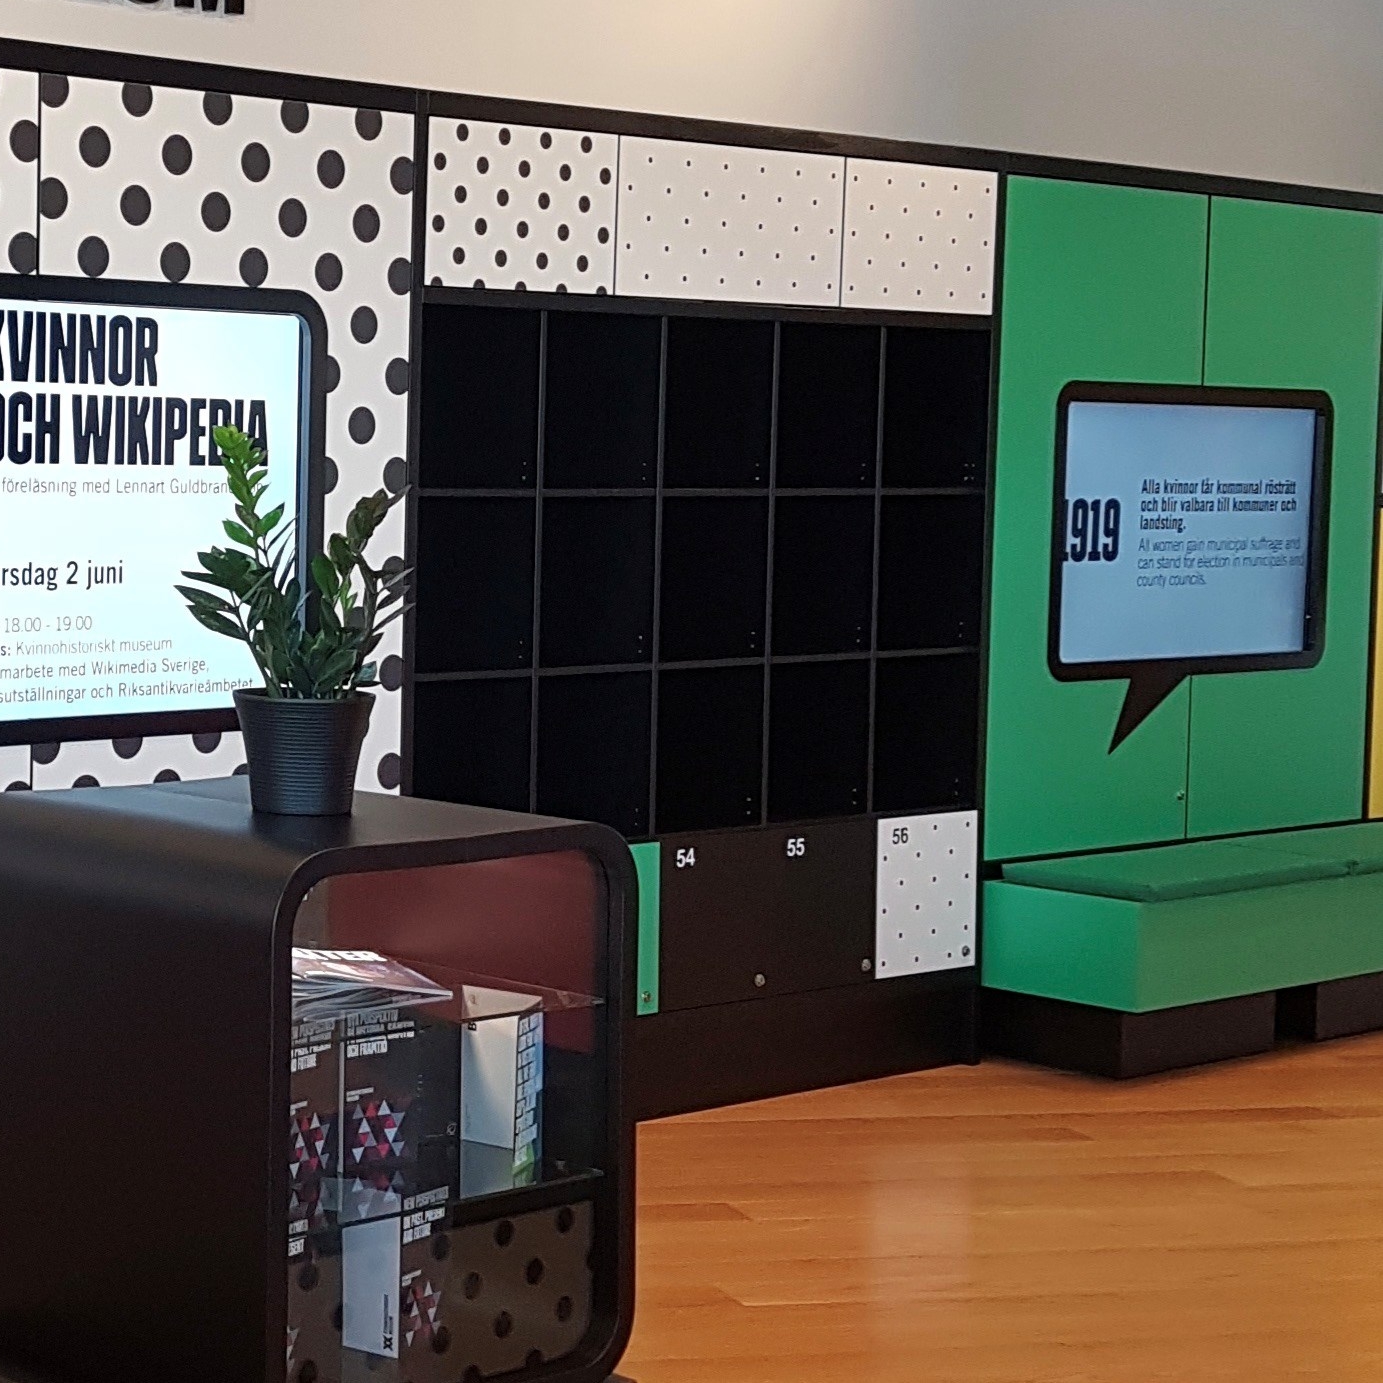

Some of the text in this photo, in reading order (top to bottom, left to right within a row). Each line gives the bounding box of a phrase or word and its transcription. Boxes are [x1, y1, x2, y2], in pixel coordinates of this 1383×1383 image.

[2, 476, 76, 497] föreläsning
[82, 479, 110, 494] med
[116, 478, 165, 494] Lennart
[1141, 479, 1160, 494] Alla
[1164, 479, 1198, 494] kvinnor
[1217, 480, 1262, 494] kommunal
[1265, 480, 1296, 494] rösträtt
[1141, 497, 1297, 512] och blir valbara till kommuner och
[1140, 515, 1186, 533] landsting.
[66, 560, 78, 585] 2
[86, 559, 123, 591] juni
[4, 617, 42, 634] 18.00
[16, 638, 115, 656] Kvinnohistoriskt
[119, 639, 173, 652] museum
[58, 662, 86, 677] med
[91, 659, 157, 676] Wikimedia
[162, 657, 209, 674] Sverige,
[91, 682, 113, 698] och
[892, 828, 909, 844] 56
[787, 838, 805, 856] 55
[676, 849, 695, 867] 54
